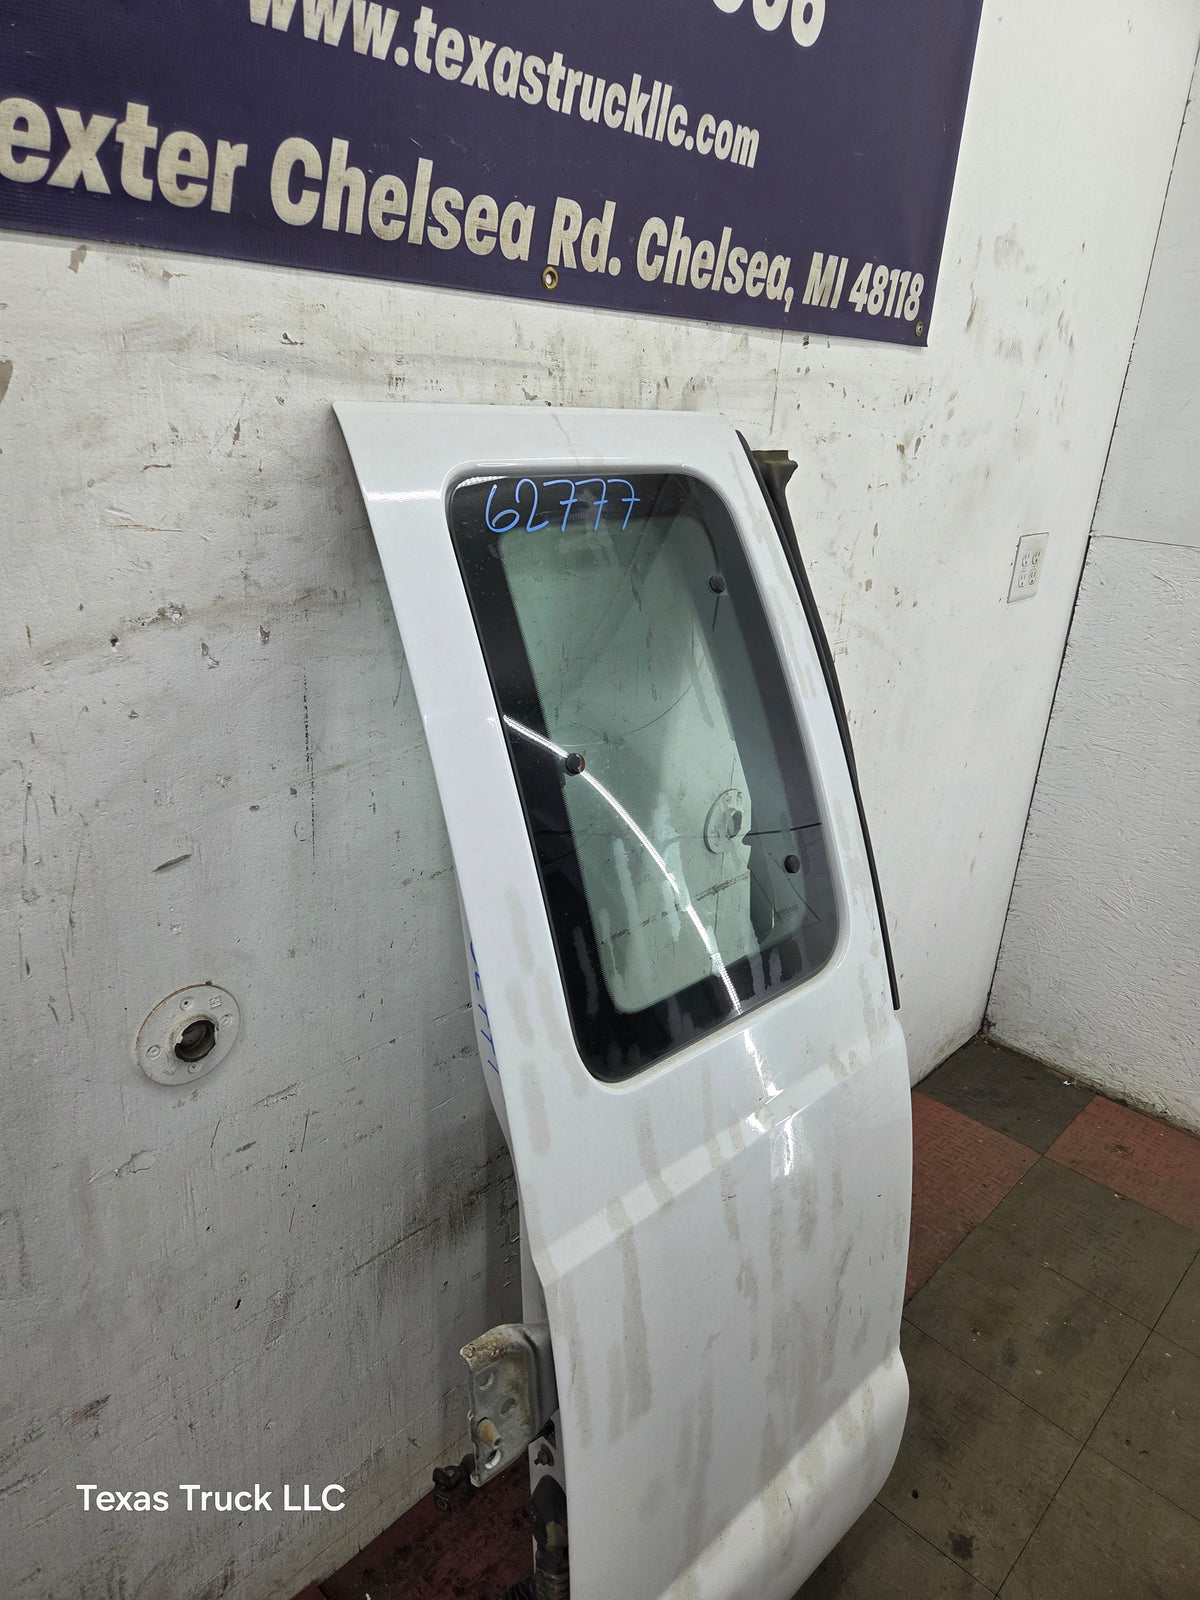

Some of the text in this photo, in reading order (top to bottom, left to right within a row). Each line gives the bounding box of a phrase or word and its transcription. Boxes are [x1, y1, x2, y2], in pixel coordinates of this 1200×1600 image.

[269, 136, 536, 262] Chelsea
[546, 196, 622, 276] Rd.
[637, 215, 794, 313] Chelsea,
[802, 251, 849, 309] MI
[848, 262, 925, 321] 48118
[485, 478, 641, 533] 62777
